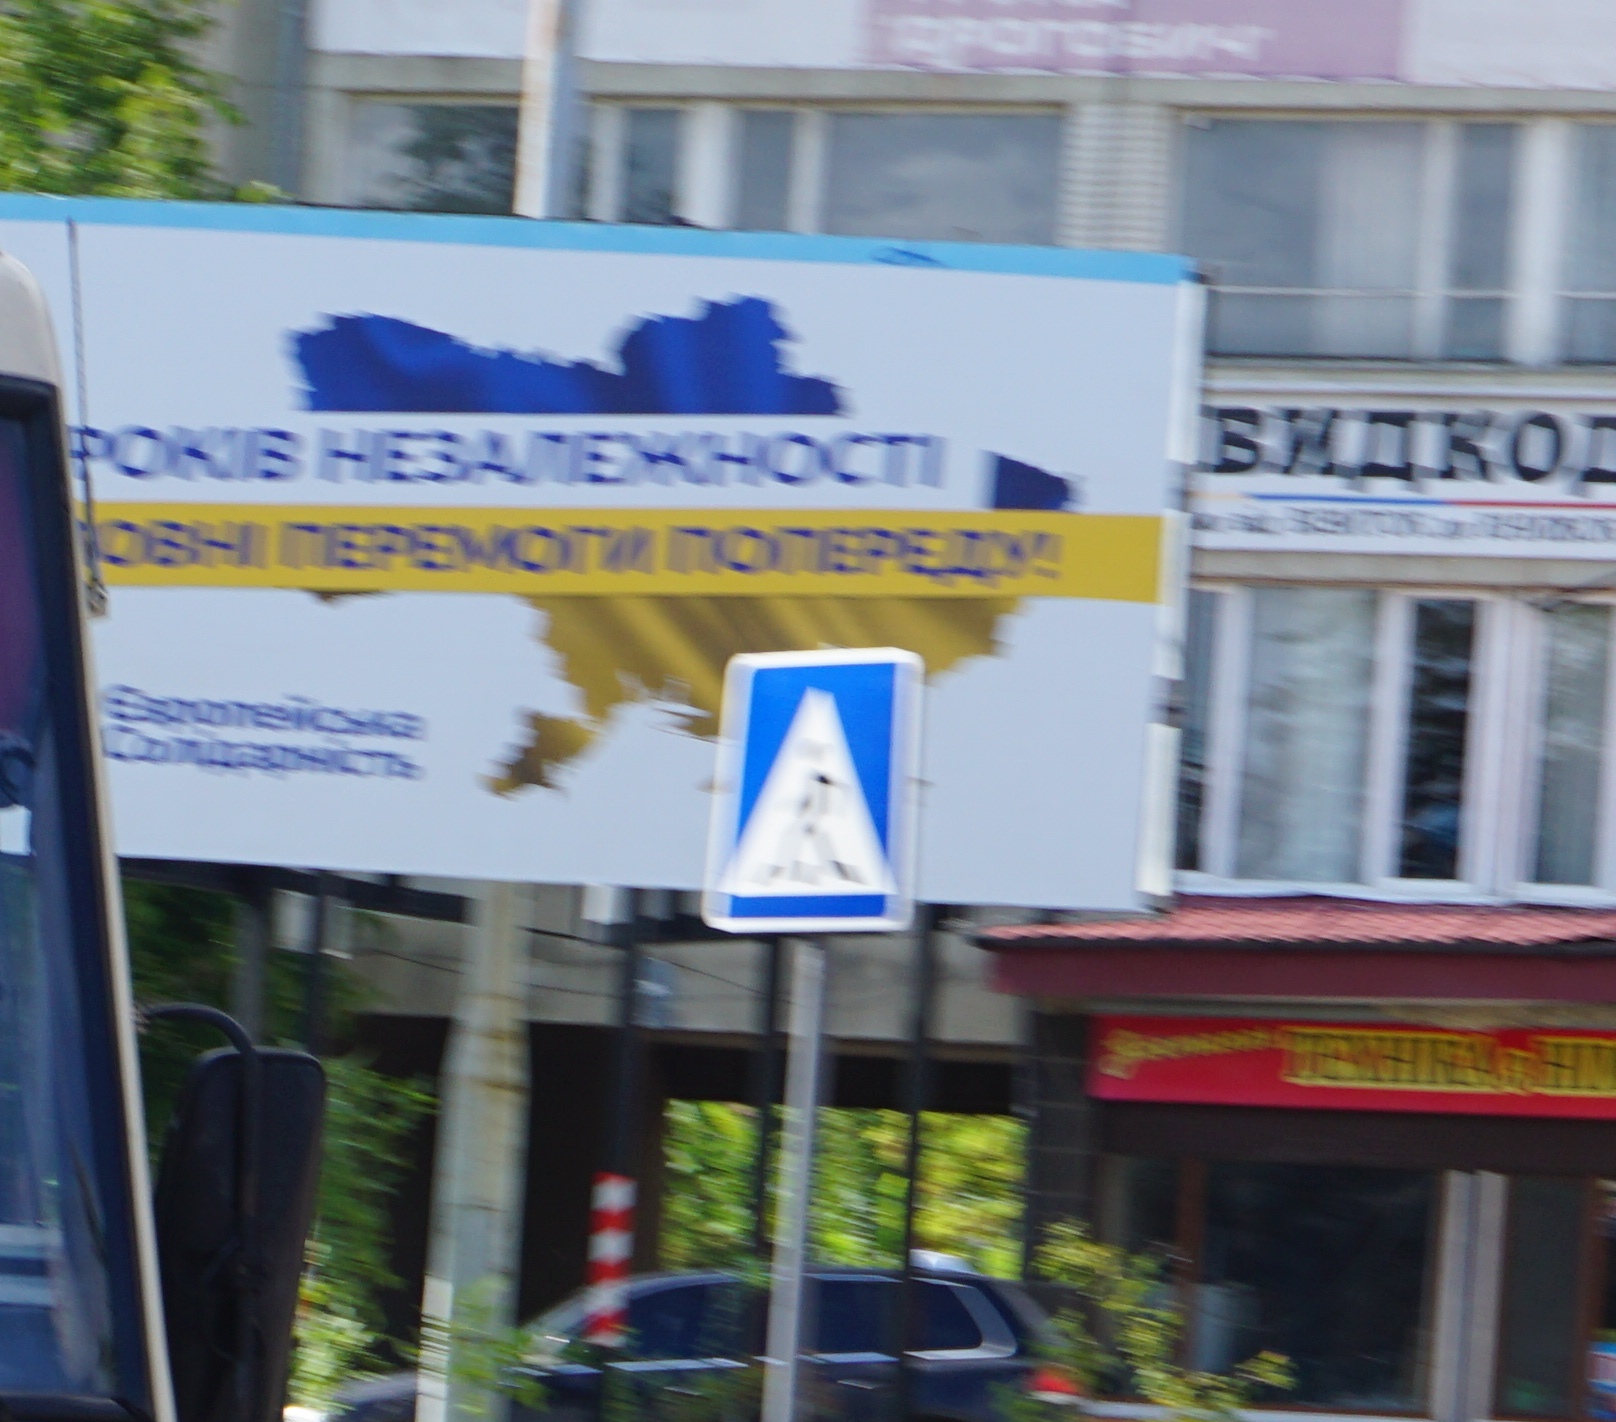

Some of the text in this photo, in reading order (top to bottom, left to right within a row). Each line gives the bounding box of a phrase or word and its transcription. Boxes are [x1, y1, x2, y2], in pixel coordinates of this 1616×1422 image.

[316, 427, 946, 490] НЕЗАЛЕЖНОСТІ
[277, 520, 658, 577] ПЕРЕМОГИ
[666, 525, 1064, 588] ПОПЕРЕДУ!
